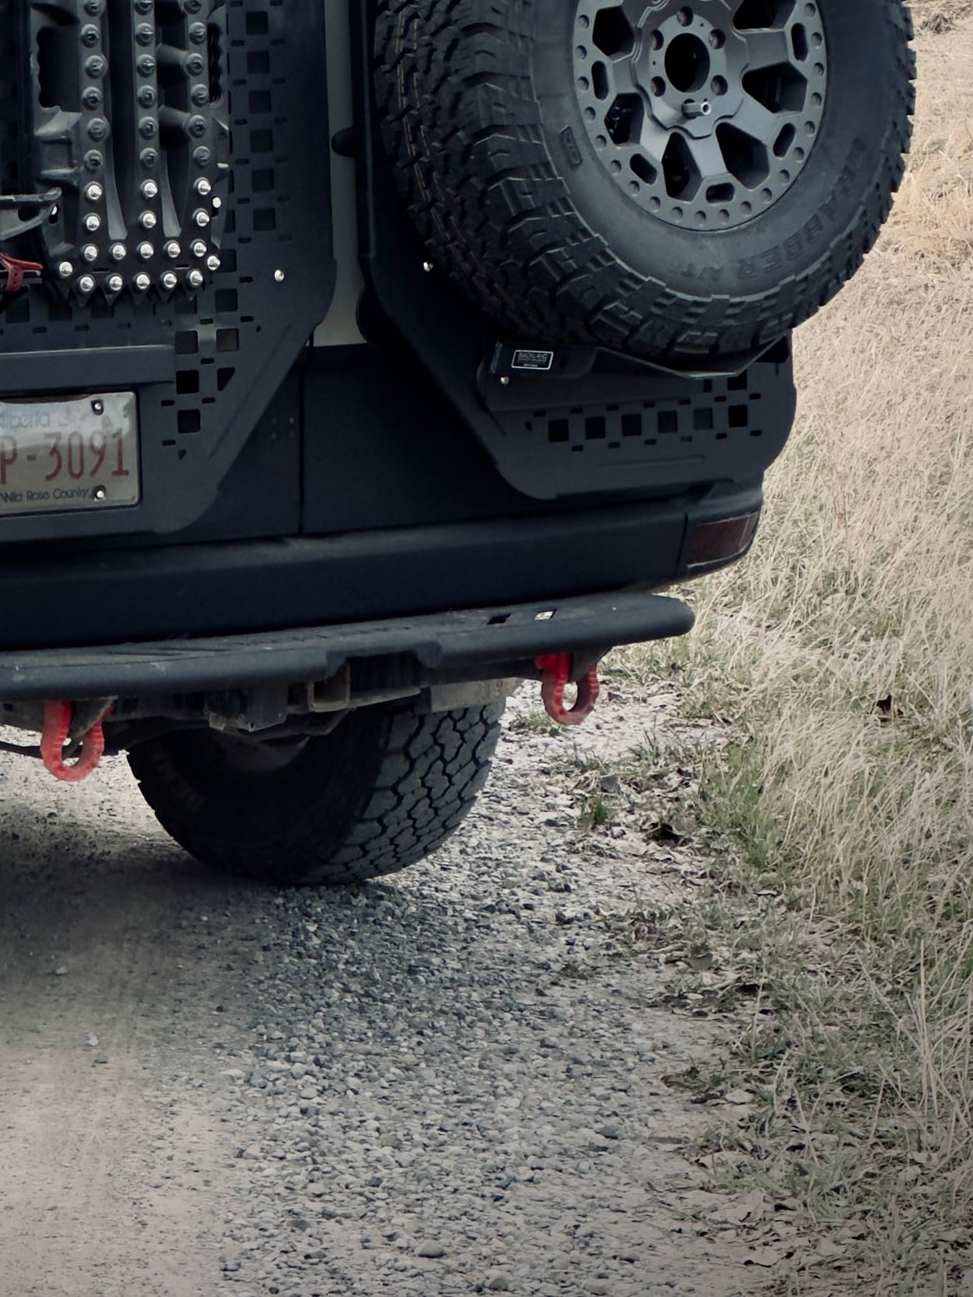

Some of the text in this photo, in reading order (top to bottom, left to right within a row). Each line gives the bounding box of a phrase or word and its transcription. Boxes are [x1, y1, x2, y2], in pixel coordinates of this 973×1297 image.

[0, 486, 90, 503] Wild Rose Country
